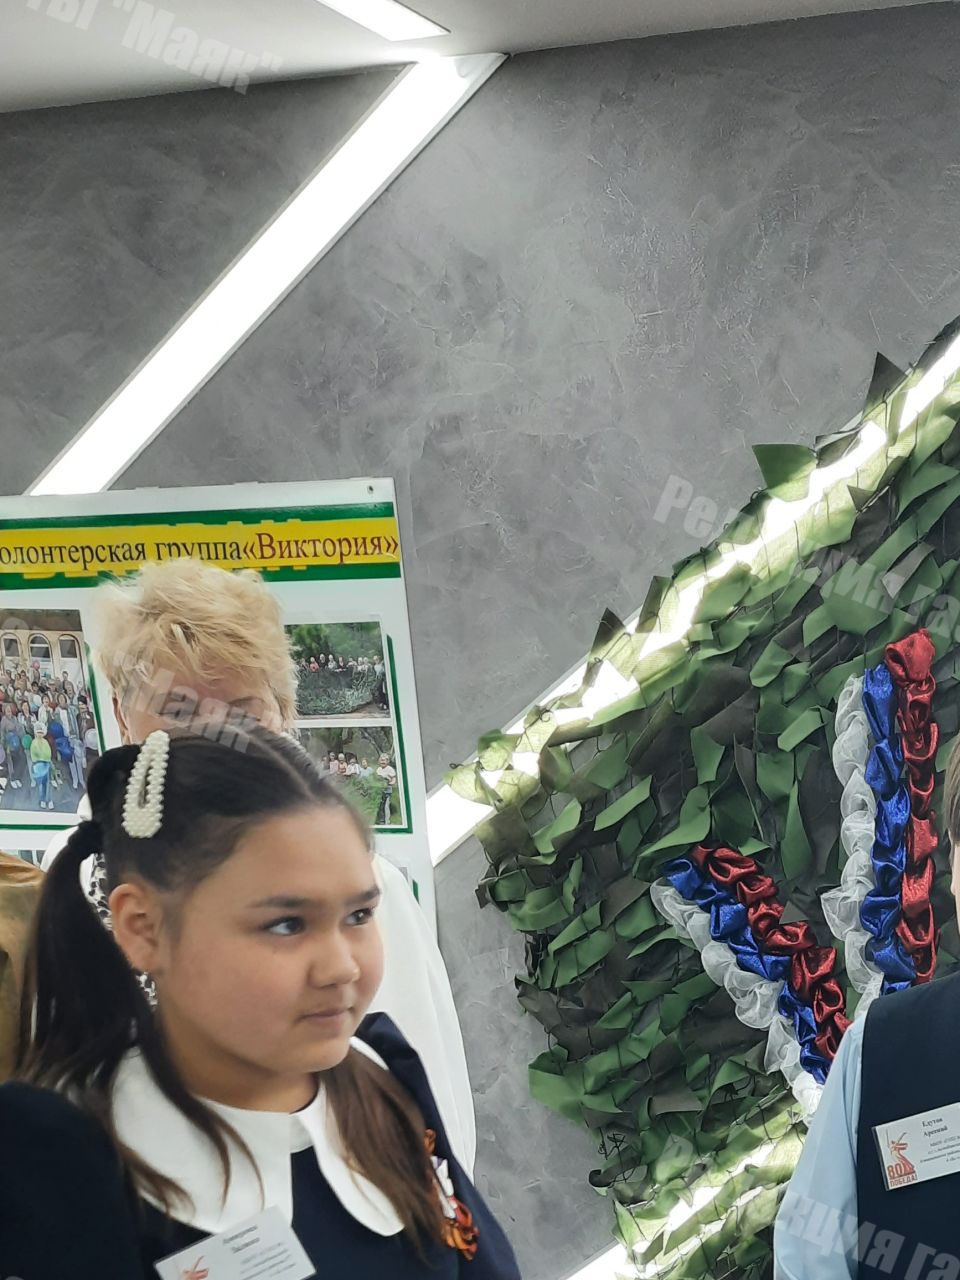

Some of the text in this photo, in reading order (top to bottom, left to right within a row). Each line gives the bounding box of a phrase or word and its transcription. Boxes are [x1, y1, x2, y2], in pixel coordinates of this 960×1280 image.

[0, 542, 147, 570] олонтерская
[887, 1162, 903, 1179] 80
[890, 1173, 918, 1187] ПОБЕДА!
